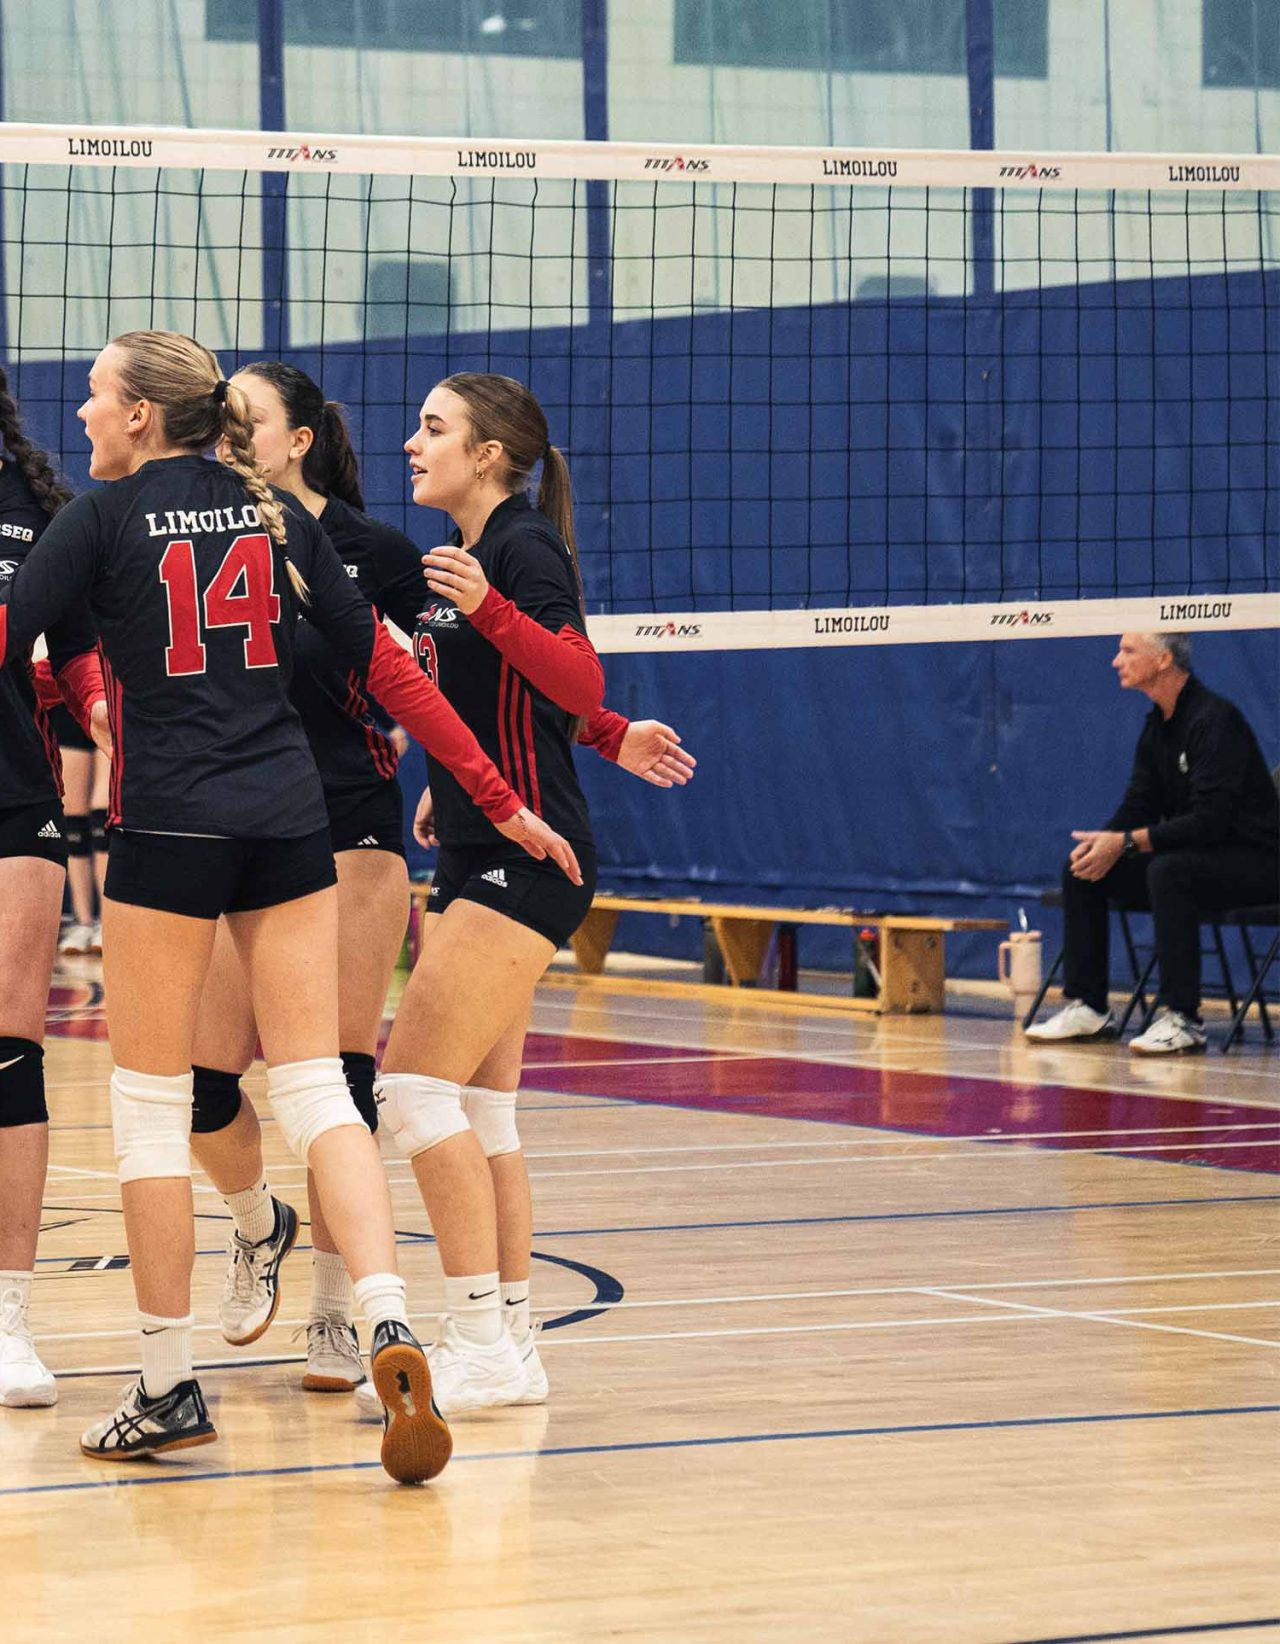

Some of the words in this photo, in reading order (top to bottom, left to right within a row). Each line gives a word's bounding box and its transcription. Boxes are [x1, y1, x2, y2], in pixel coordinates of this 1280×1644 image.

[68, 138, 152, 157] LIMOILOU
[267, 144, 337, 162] TITANS
[457, 151, 536, 169] LIMOILOU
[643, 153, 710, 172] TITANS
[822, 159, 897, 177] LIMOILOU
[998, 163, 1062, 180] TITANS
[1168, 165, 1240, 182] LIMOILOU
[158, 533, 281, 677] 14
[634, 621, 702, 638] TITANS
[814, 615, 890, 634] LIMOILOU
[990, 610, 1054, 626] TITANS
[1160, 602, 1232, 621] LIMOILOU
